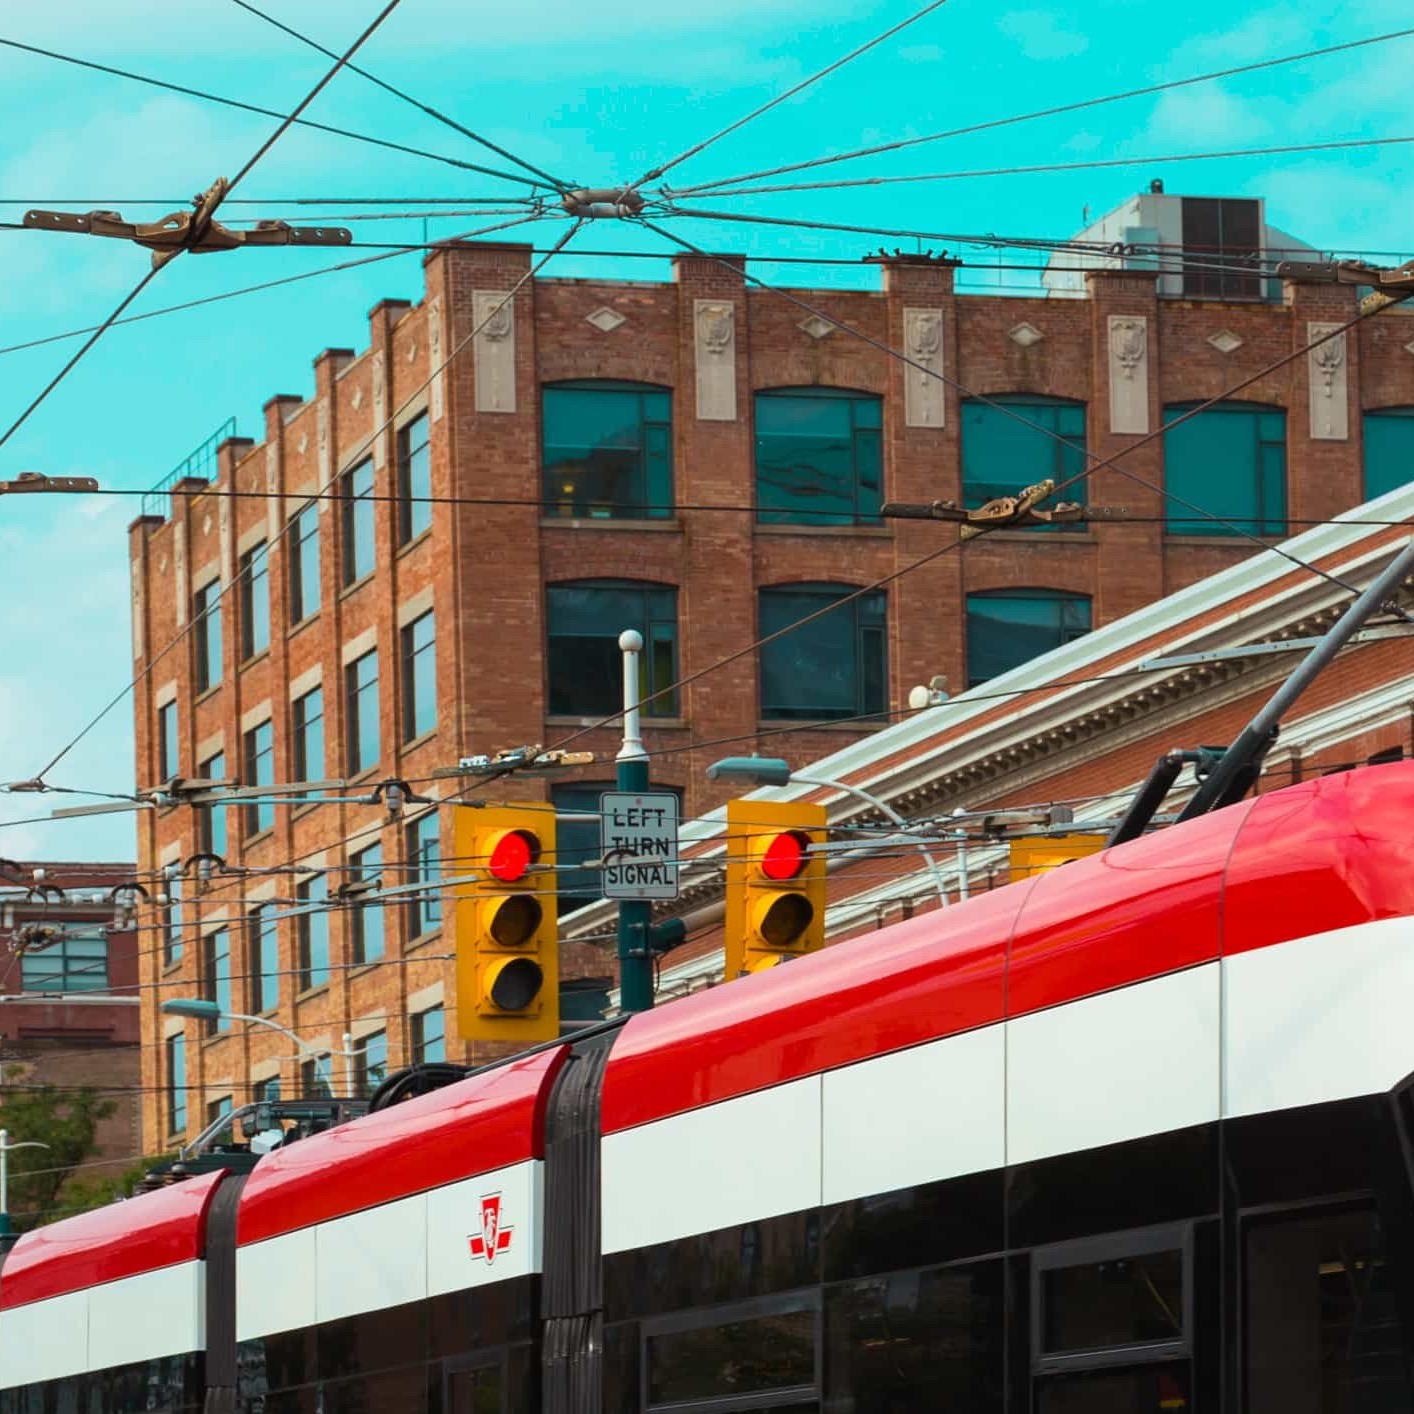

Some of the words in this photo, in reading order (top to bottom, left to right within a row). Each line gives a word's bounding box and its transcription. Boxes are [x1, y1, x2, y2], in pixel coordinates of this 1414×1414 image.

[613, 807, 666, 828] LEFT
[611, 836, 670, 857] TURN
[607, 865, 674, 885] SIGNAL
